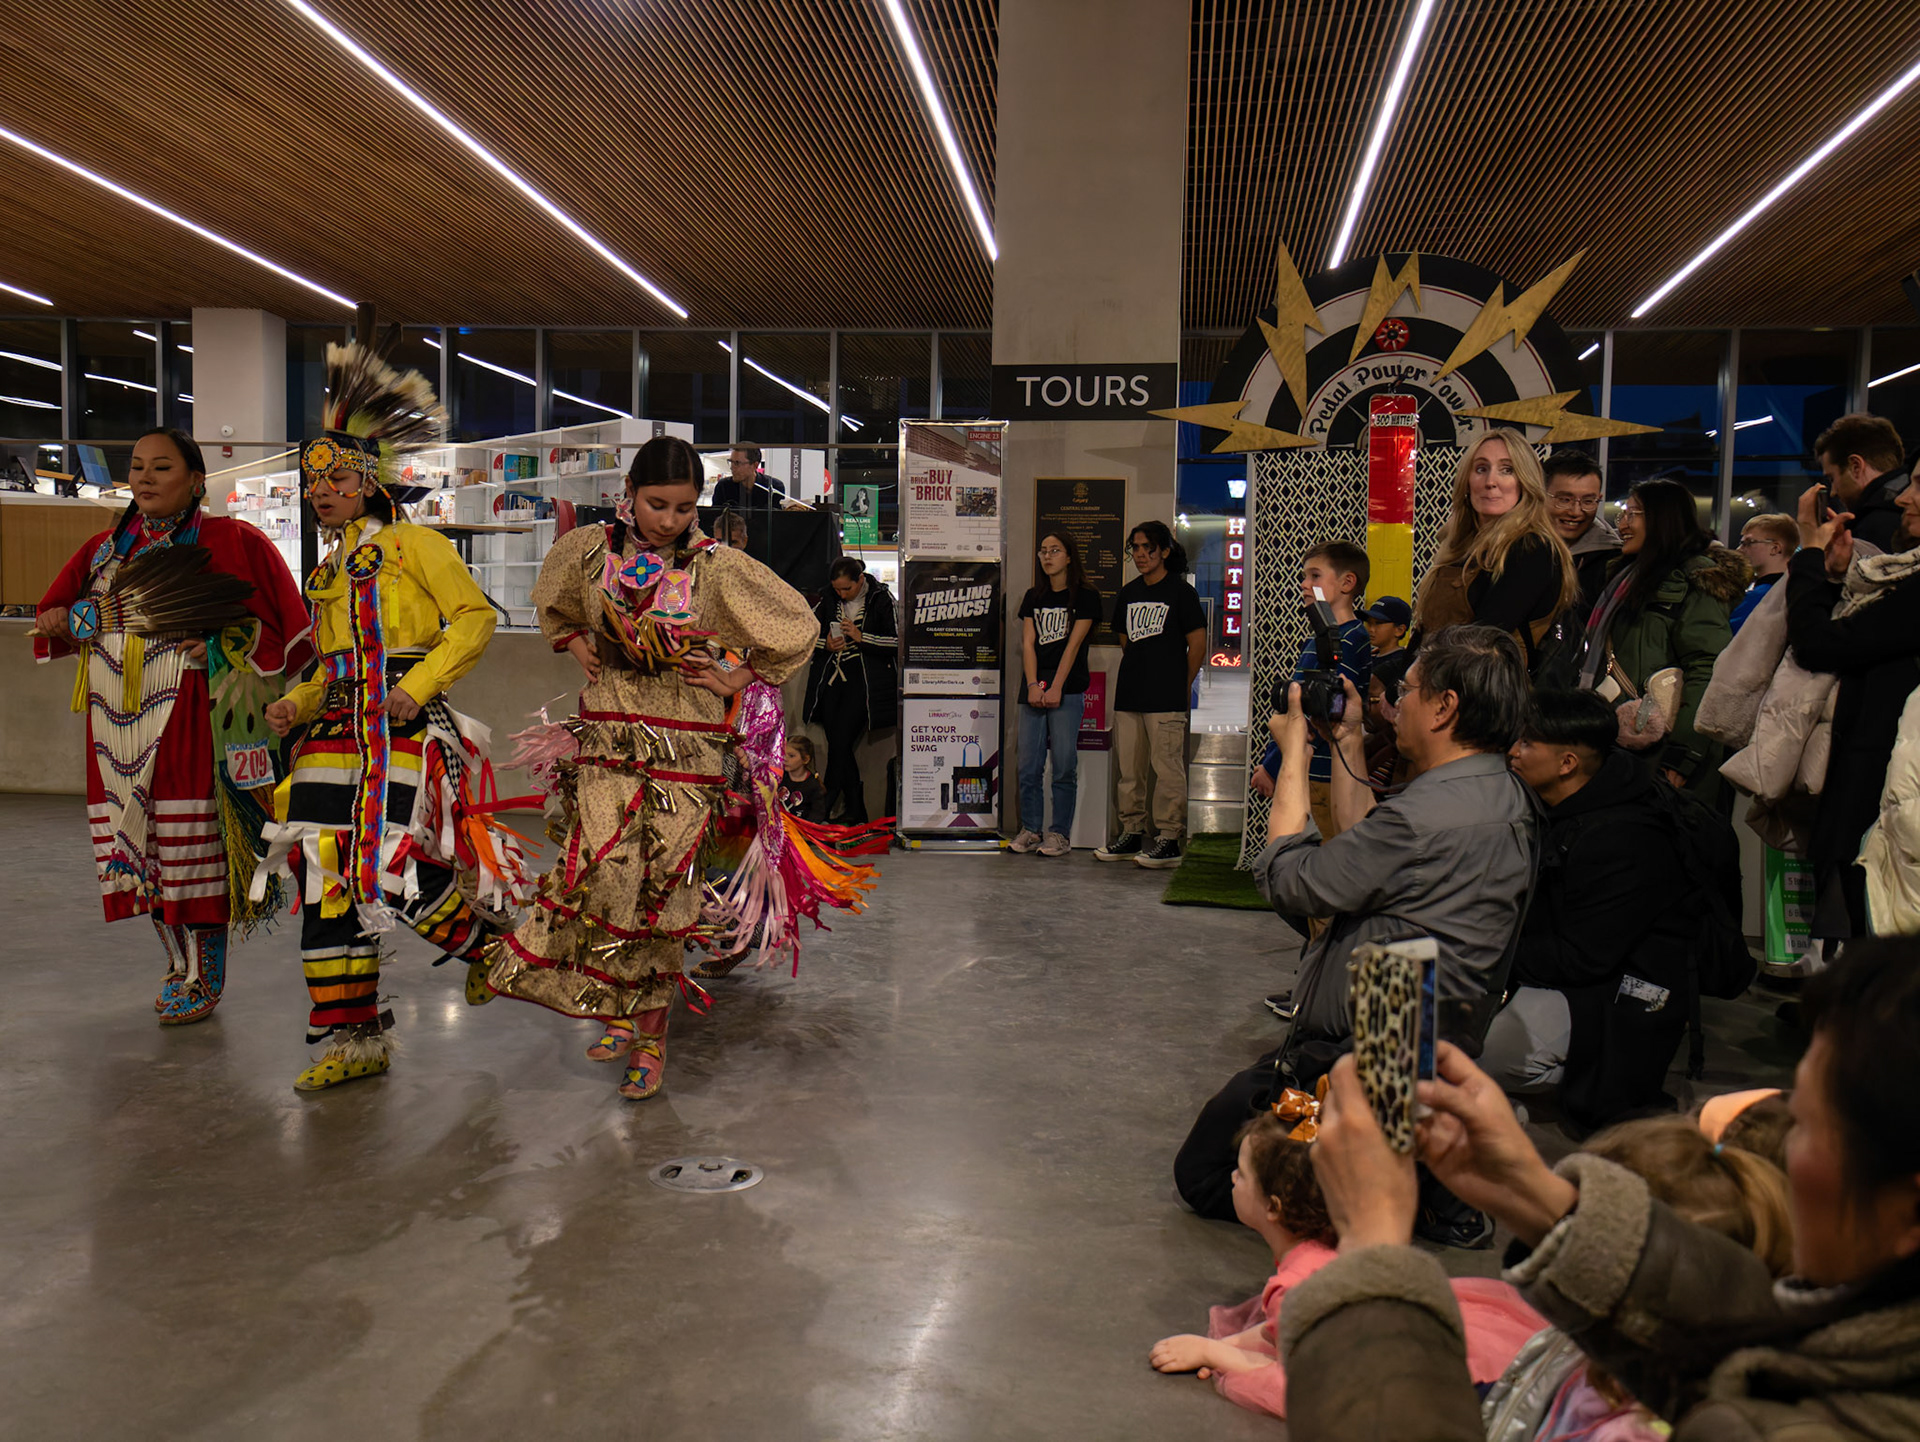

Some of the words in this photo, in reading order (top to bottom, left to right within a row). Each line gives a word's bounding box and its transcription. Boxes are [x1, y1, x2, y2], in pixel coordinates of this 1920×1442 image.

[1016, 375, 1149, 407] TOURS
[1309, 380, 1353, 434] Pedal
[1352, 363, 1427, 386] Power
[1376, 414, 1390, 425] 300
[910, 476, 928, 485] BRICK
[929, 469, 953, 485] BUY
[916, 485, 952, 501] BRICK
[1226, 518, 1246, 634] HOTEL
[915, 584, 992, 608] THRILLING
[914, 599, 991, 625] HEROICS!
[1131, 605, 1168, 631] YOUTH
[1036, 610, 1067, 635] YOUT
[1041, 631, 1066, 643] CENTR
[1131, 627, 1162, 640] CENTRAL
[1083, 693, 1099, 701] OUR
[911, 725, 929, 734] GET
[931, 725, 956, 733] YOUR
[911, 735, 949, 743] LIBRARY
[950, 735, 980, 743] STORE
[911, 744, 938, 752] SWAG
[234, 748, 267, 781] 209
[957, 783, 988, 794] SHELF
